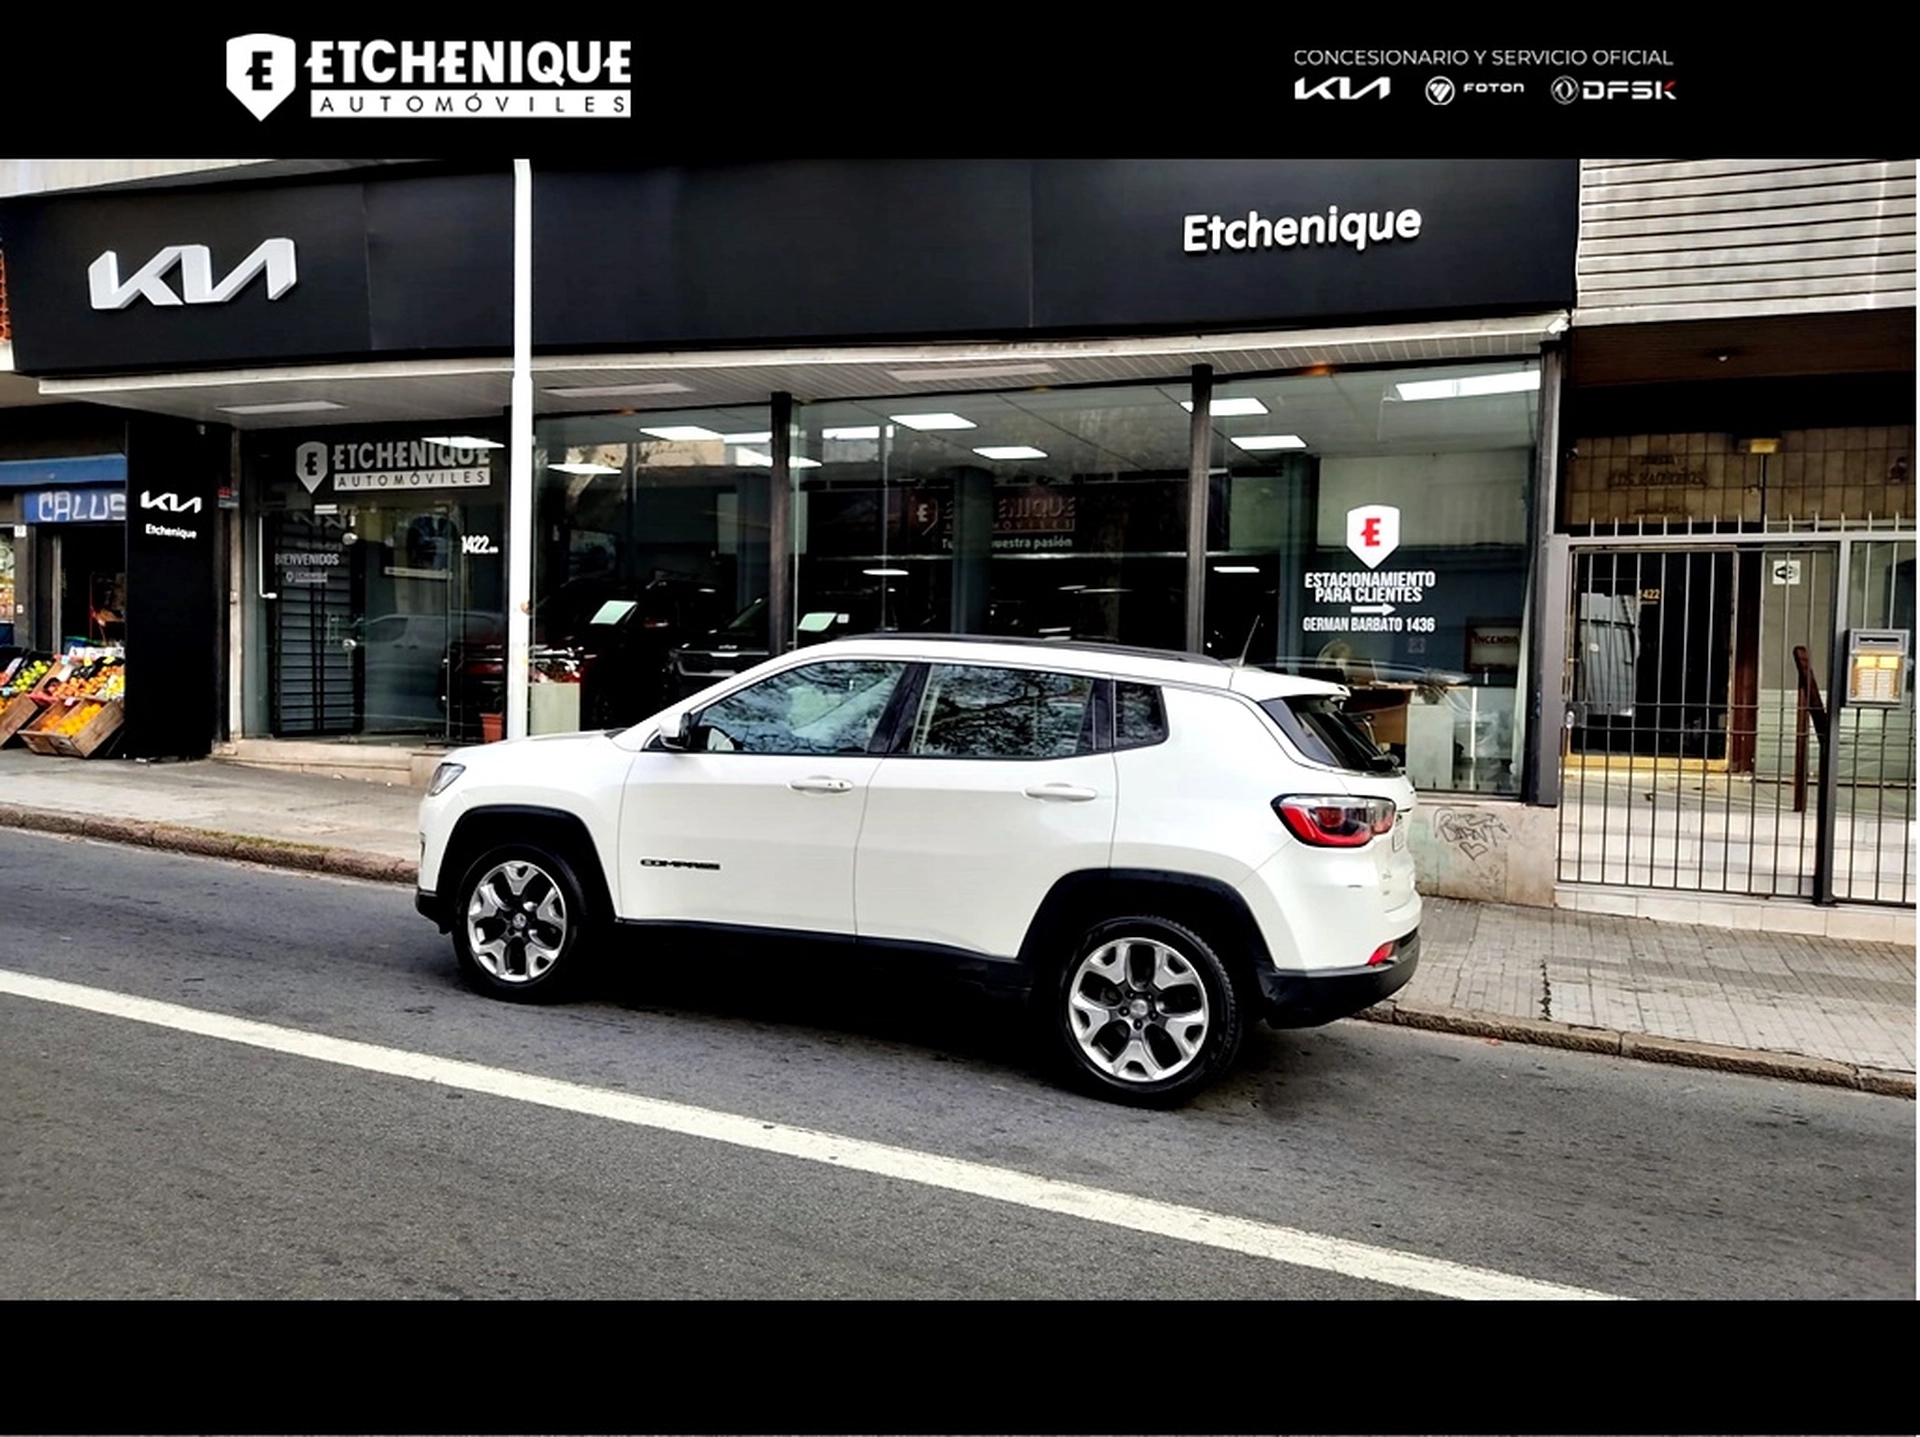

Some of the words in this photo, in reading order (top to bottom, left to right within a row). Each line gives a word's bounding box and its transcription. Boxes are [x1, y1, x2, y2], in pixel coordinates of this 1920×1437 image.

[1184, 205, 1422, 251] Etchenique
[88, 237, 297, 310] KIA
[331, 437, 490, 471] ETCHENIQUE
[337, 471, 486, 488] AUTOMÓVILES
[141, 490, 202, 514] KIA
[145, 524, 197, 540] Etchenique
[1304, 571, 1437, 588] ESTACIONAMIENTO
[1315, 587, 1352, 603] PARA
[1354, 586, 1424, 603] CLIENTES
[1302, 617, 1349, 631] GERMAN
[1350, 617, 1403, 632] BARBATO
[1406, 617, 1436, 632] 1436
